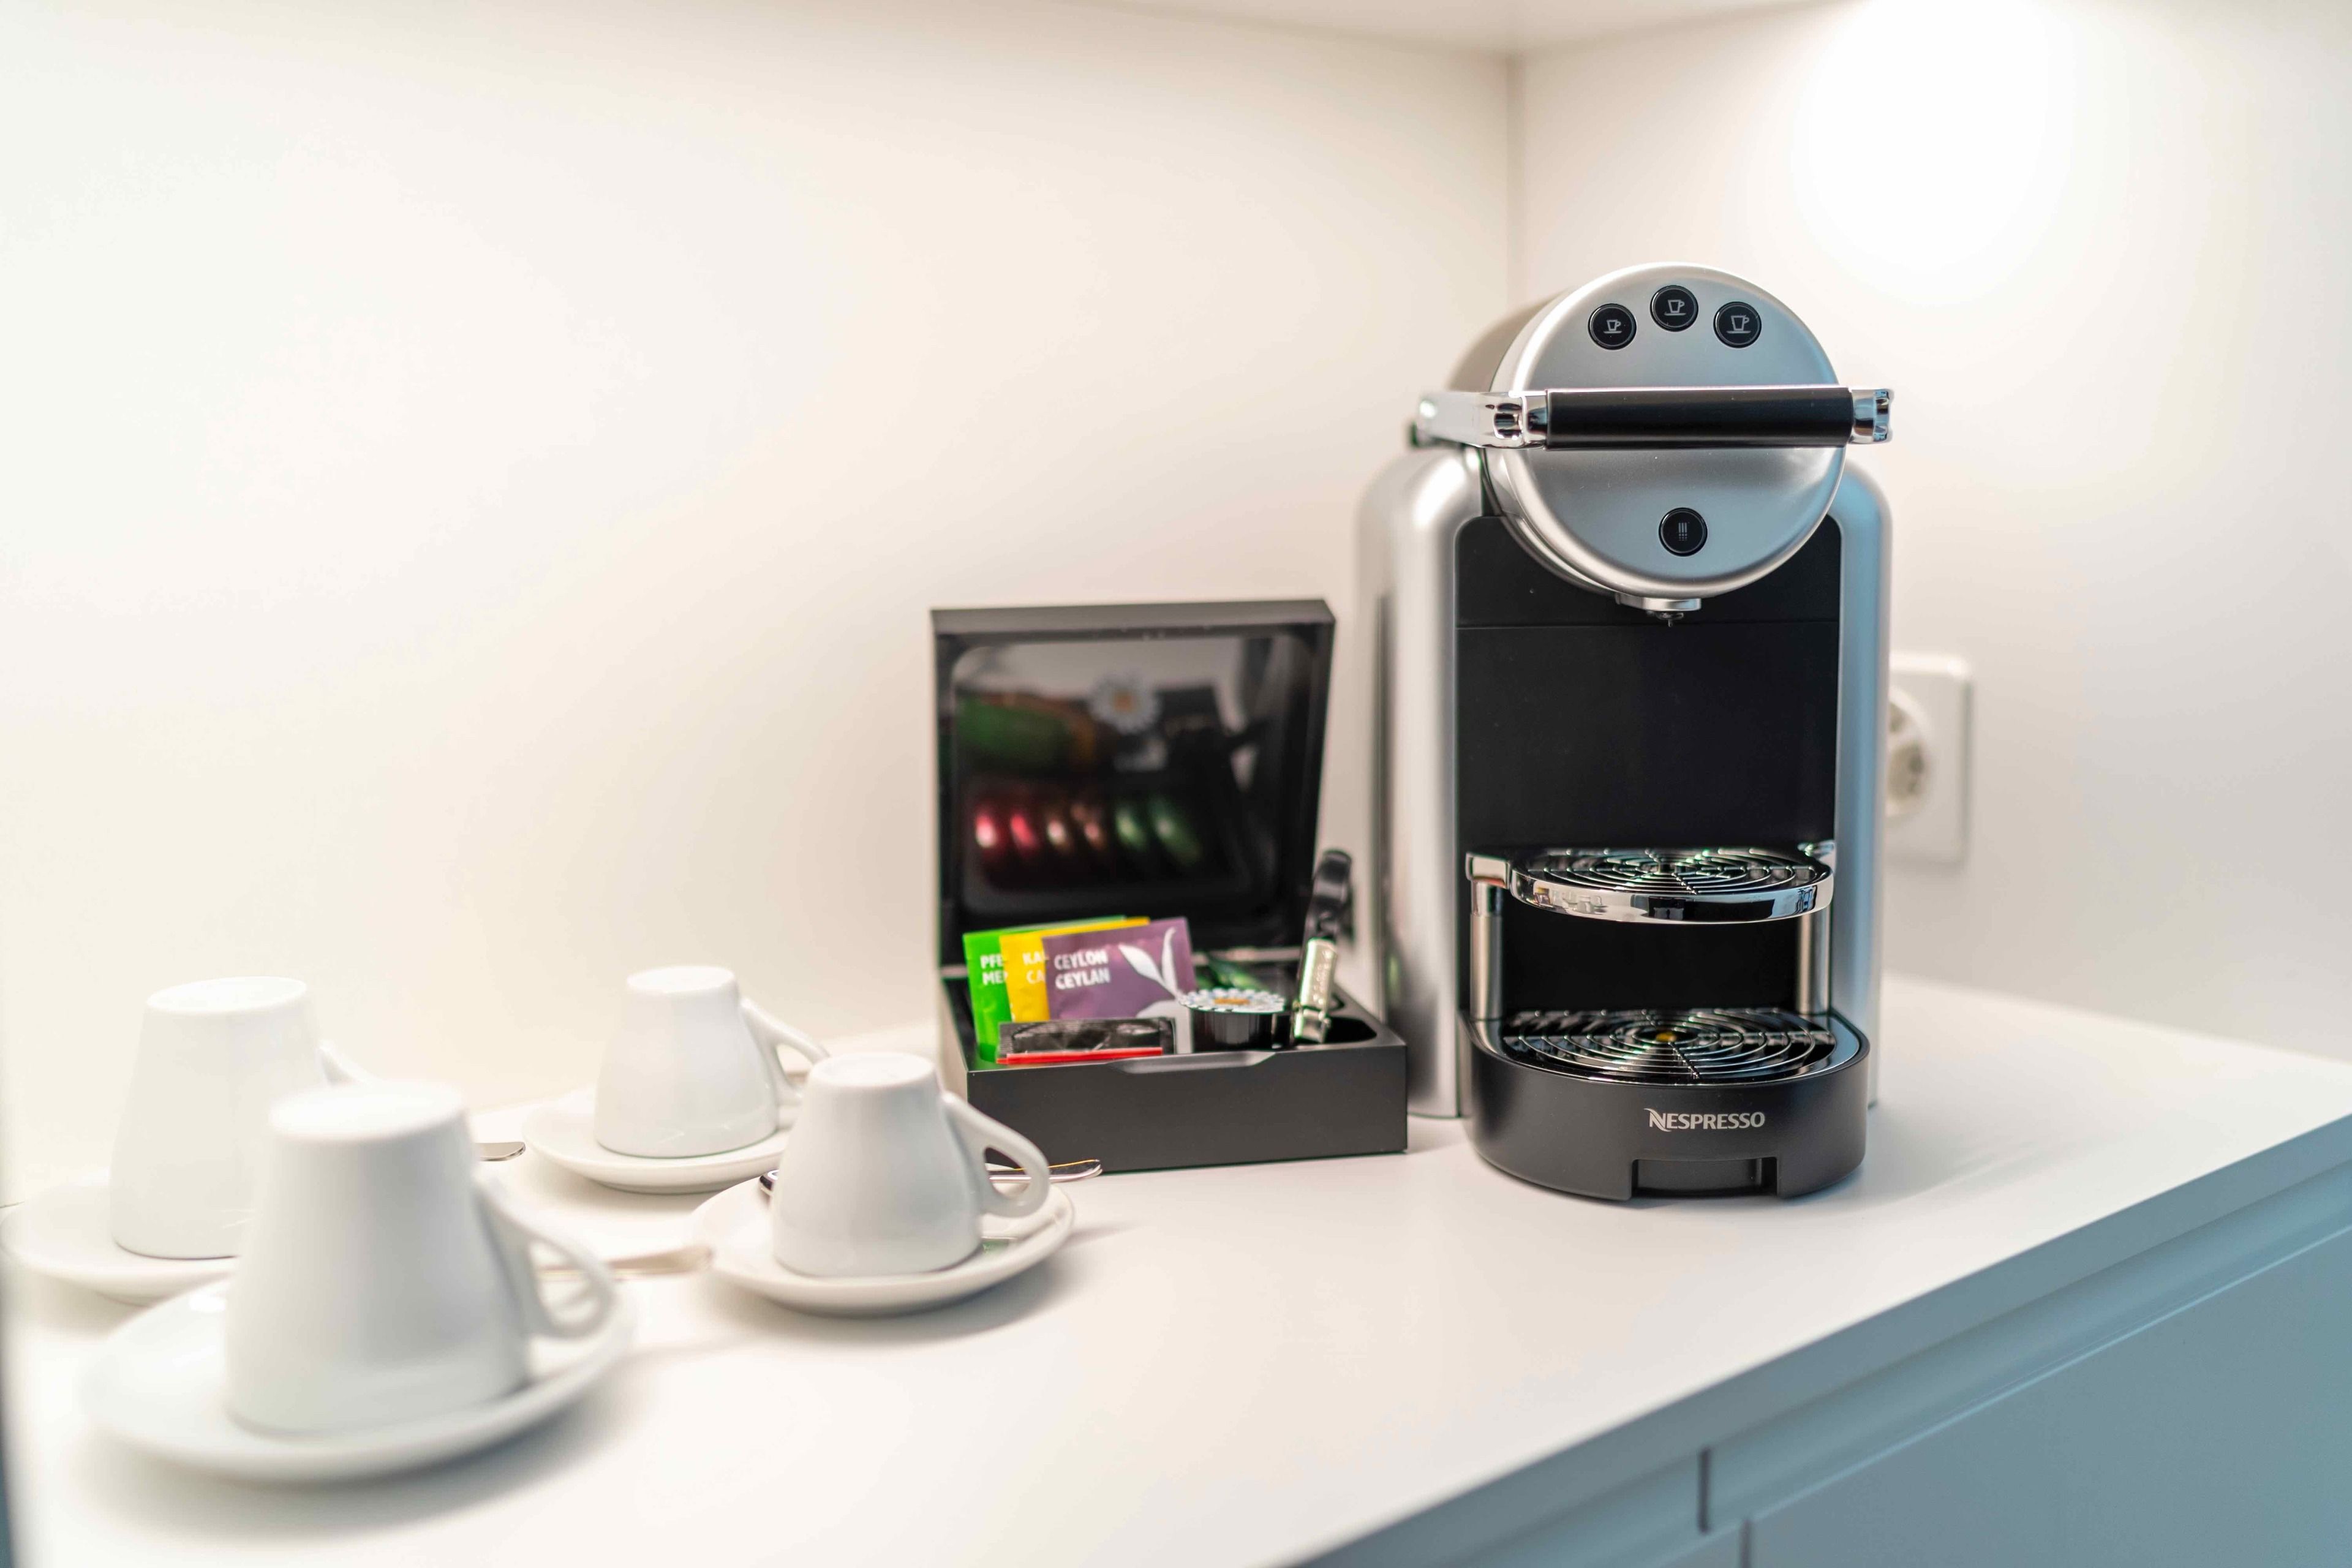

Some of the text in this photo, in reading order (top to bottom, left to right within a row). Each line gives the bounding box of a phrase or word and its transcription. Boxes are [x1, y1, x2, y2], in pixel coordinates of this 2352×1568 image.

[1022, 951, 1047, 966] KA
[1054, 949, 1108, 970] CEYLON
[1055, 968, 1110, 990] CEYLAN
[1644, 1108, 1765, 1132] NESPRESSO
